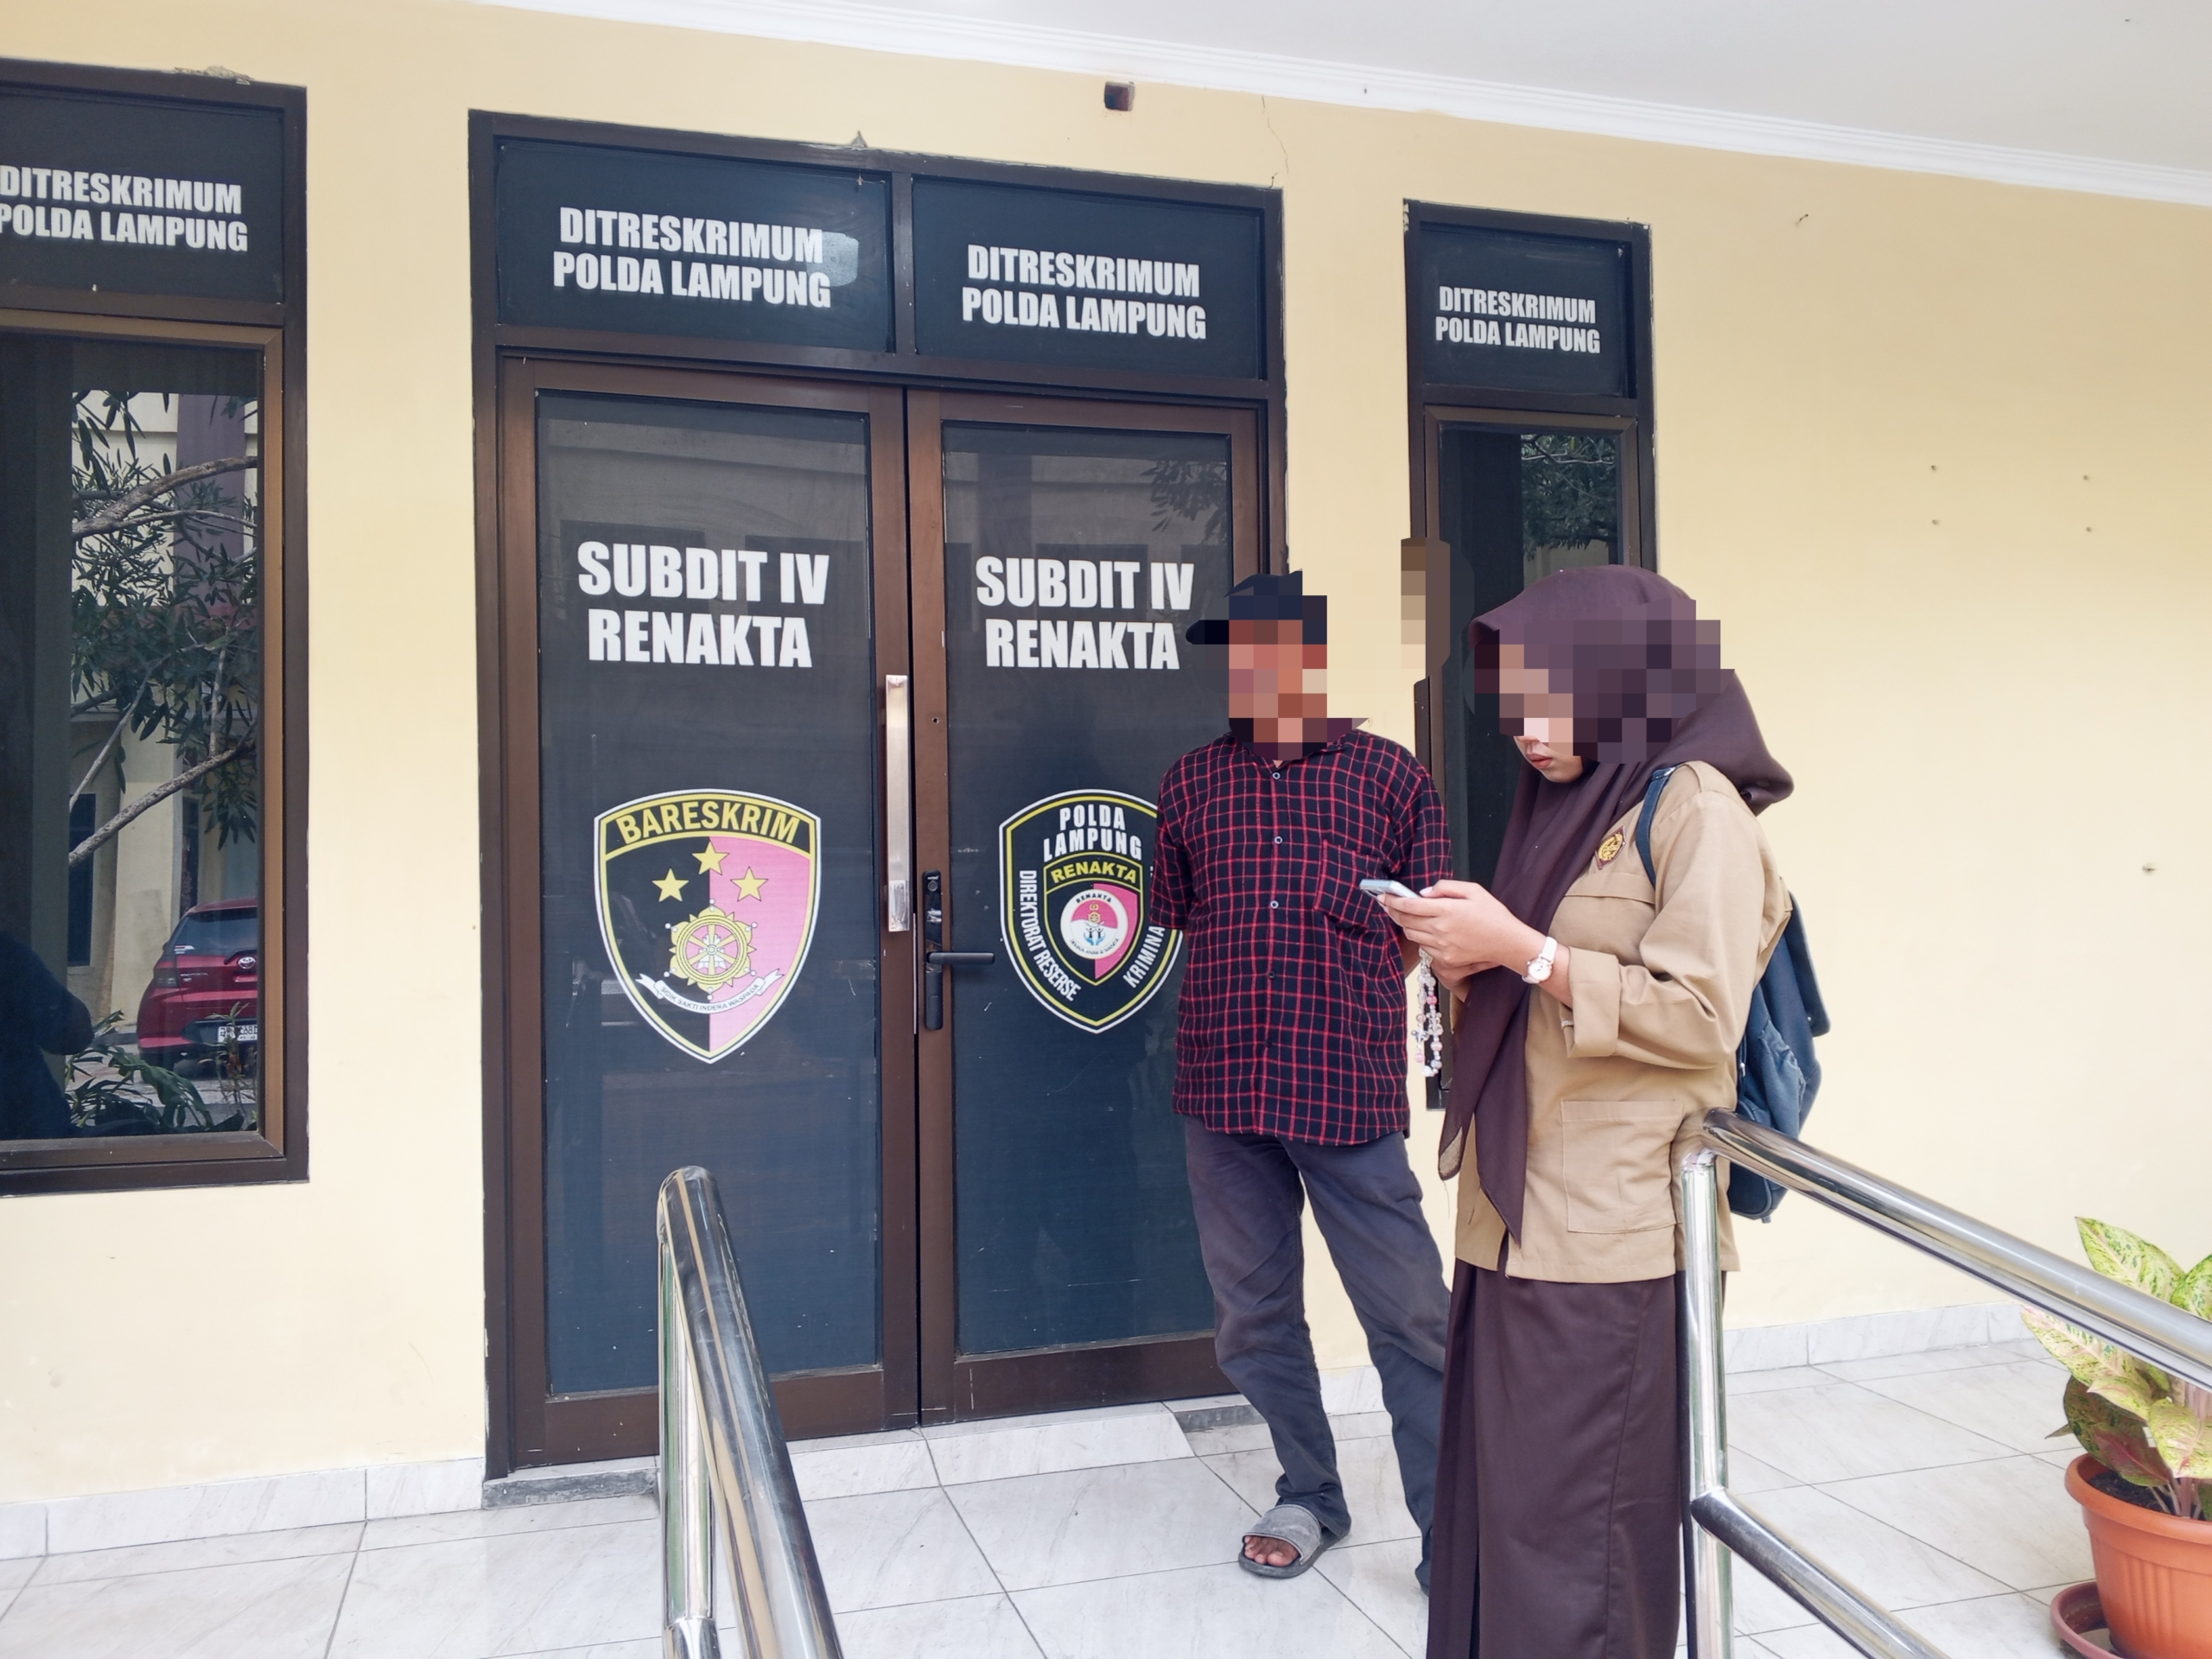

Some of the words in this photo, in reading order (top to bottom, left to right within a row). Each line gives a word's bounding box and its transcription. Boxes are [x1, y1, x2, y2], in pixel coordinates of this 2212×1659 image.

[0, 165, 241, 214] DITRESKRIMUM
[100, 211, 248, 251] LAMPUNG
[560, 207, 823, 264] DITRESKRIMUM
[553, 251, 664, 295] POLDA
[671, 260, 831, 308] LAMPUNG
[968, 244, 1199, 297] DITRESKRIMUM
[962, 286, 1060, 328] POLDA
[1065, 296, 1206, 340] LAMPUNG
[1439, 285, 1596, 324] DITRESKRIMUM
[1435, 316, 1502, 346] POLDA
[1505, 321, 1600, 353] LAMPUNG
[577, 541, 768, 602] SUBDIT
[780, 552, 830, 605] IV
[976, 556, 1141, 609] SUBDIT
[1150, 562, 1194, 610] IV
[588, 608, 812, 668] RENAKTA
[985, 618, 1180, 670] RENAKTA
[616, 800, 800, 844] BARESKRIM
[1059, 804, 1126, 831] POLDA
[1043, 828, 1142, 862] LAMPUNG
[1050, 861, 1137, 884] RENAKTA
[1019, 870, 1046, 951] DIREKTORAT
[1033, 949, 1082, 1001] RESERSE
[1122, 925, 1166, 988] KRIMINA
[660, 986, 677, 1001] SIDIK
[677, 999, 699, 1010] SAKTI
[699, 1003, 728, 1012] INDERA
[728, 983, 760, 1007] WASPADA
